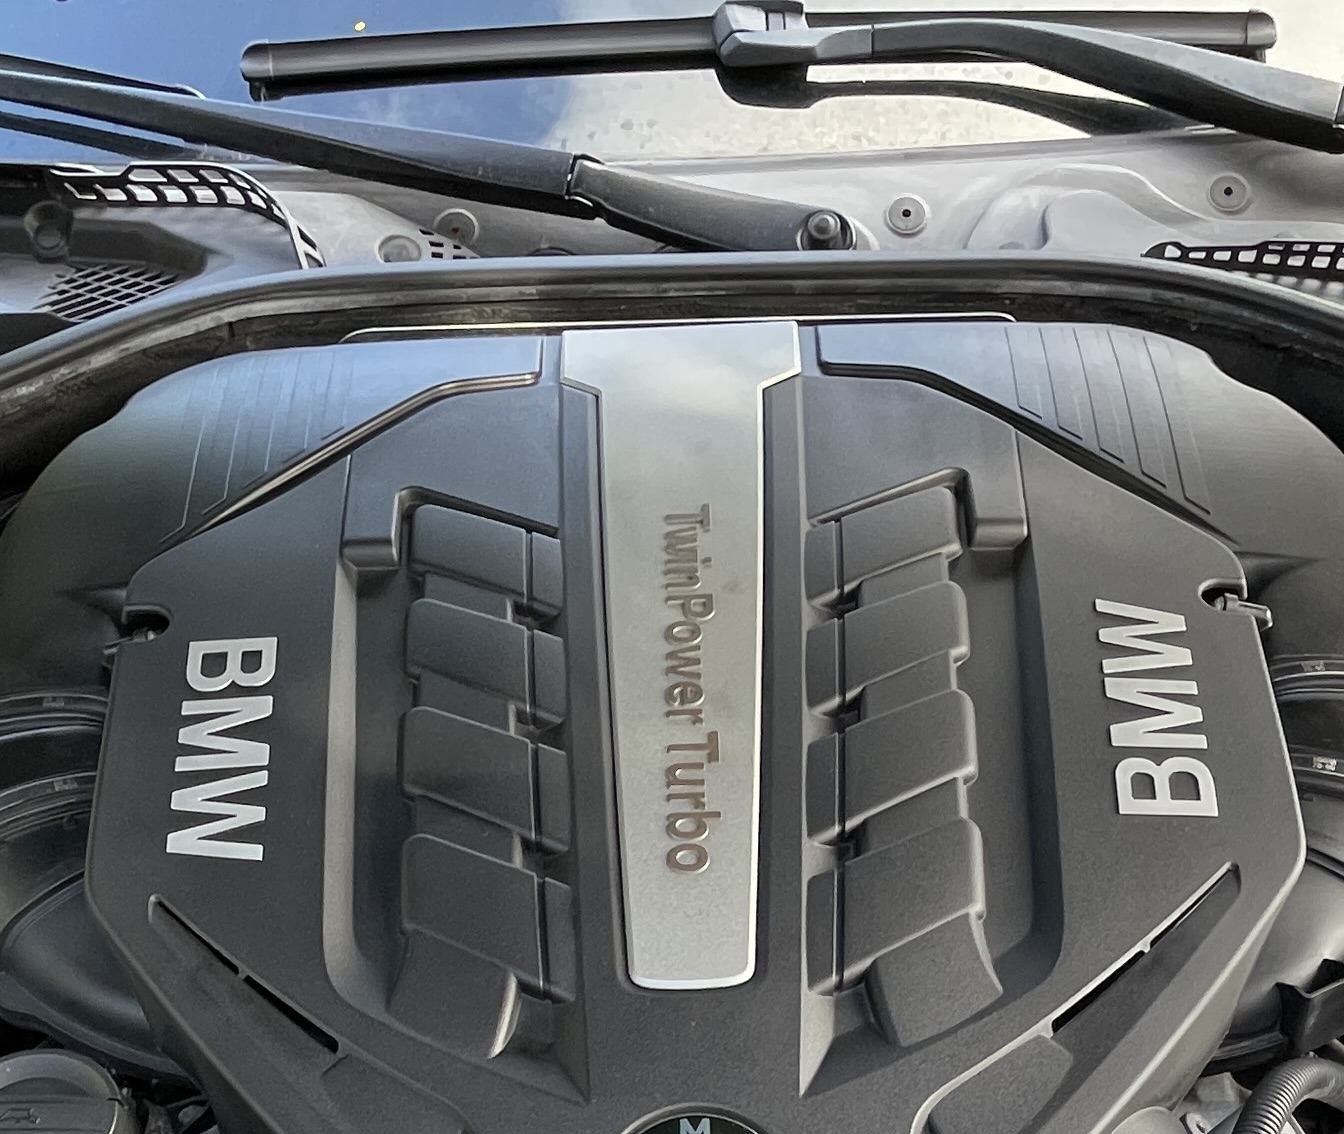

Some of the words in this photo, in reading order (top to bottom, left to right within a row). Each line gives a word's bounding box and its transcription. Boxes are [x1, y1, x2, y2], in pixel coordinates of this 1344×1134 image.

[663, 503, 716, 726] TwinPower
[1095, 598, 1219, 817] BMW
[165, 636, 279, 862] BMW
[665, 730, 722, 876] Turbo
